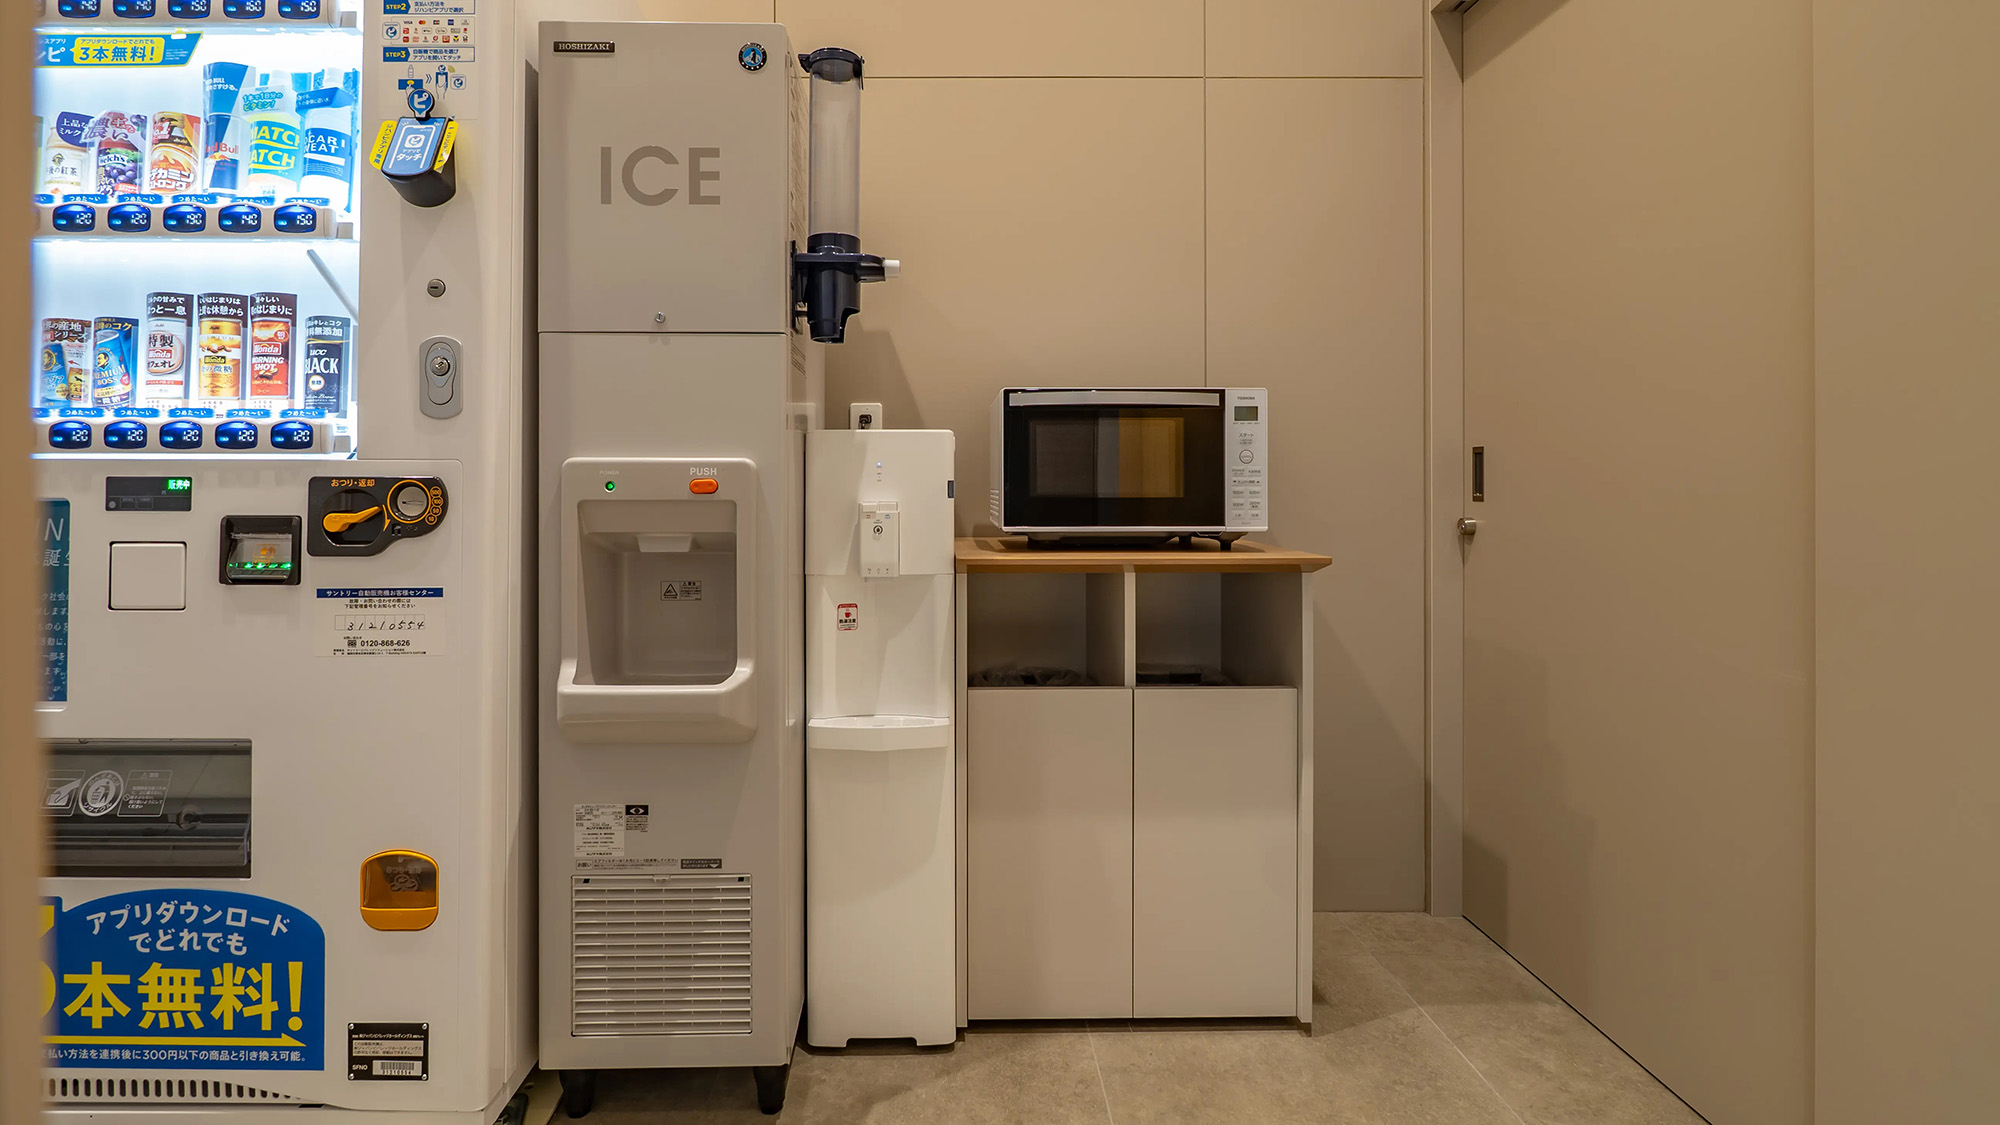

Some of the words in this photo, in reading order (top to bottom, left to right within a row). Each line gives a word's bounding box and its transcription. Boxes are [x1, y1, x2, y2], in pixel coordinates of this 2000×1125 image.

[558, 43, 610, 51] HOSHIZAKI
[600, 145, 721, 206] ICE
[72, 430, 88, 442] 120
[128, 430, 144, 442] 120
[182, 430, 198, 442] 120
[239, 430, 255, 442] 120
[294, 430, 310, 442] 120
[689, 467, 718, 476] PUSH
[331, 479, 376, 487] おつり・返却
[85, 900, 290, 938] アプリダウンロード
[128, 928, 248, 956] でどれでも
[42, 1048, 306, 1062] 払い方法を連携後に300円以下の商品と引き換え可能。
